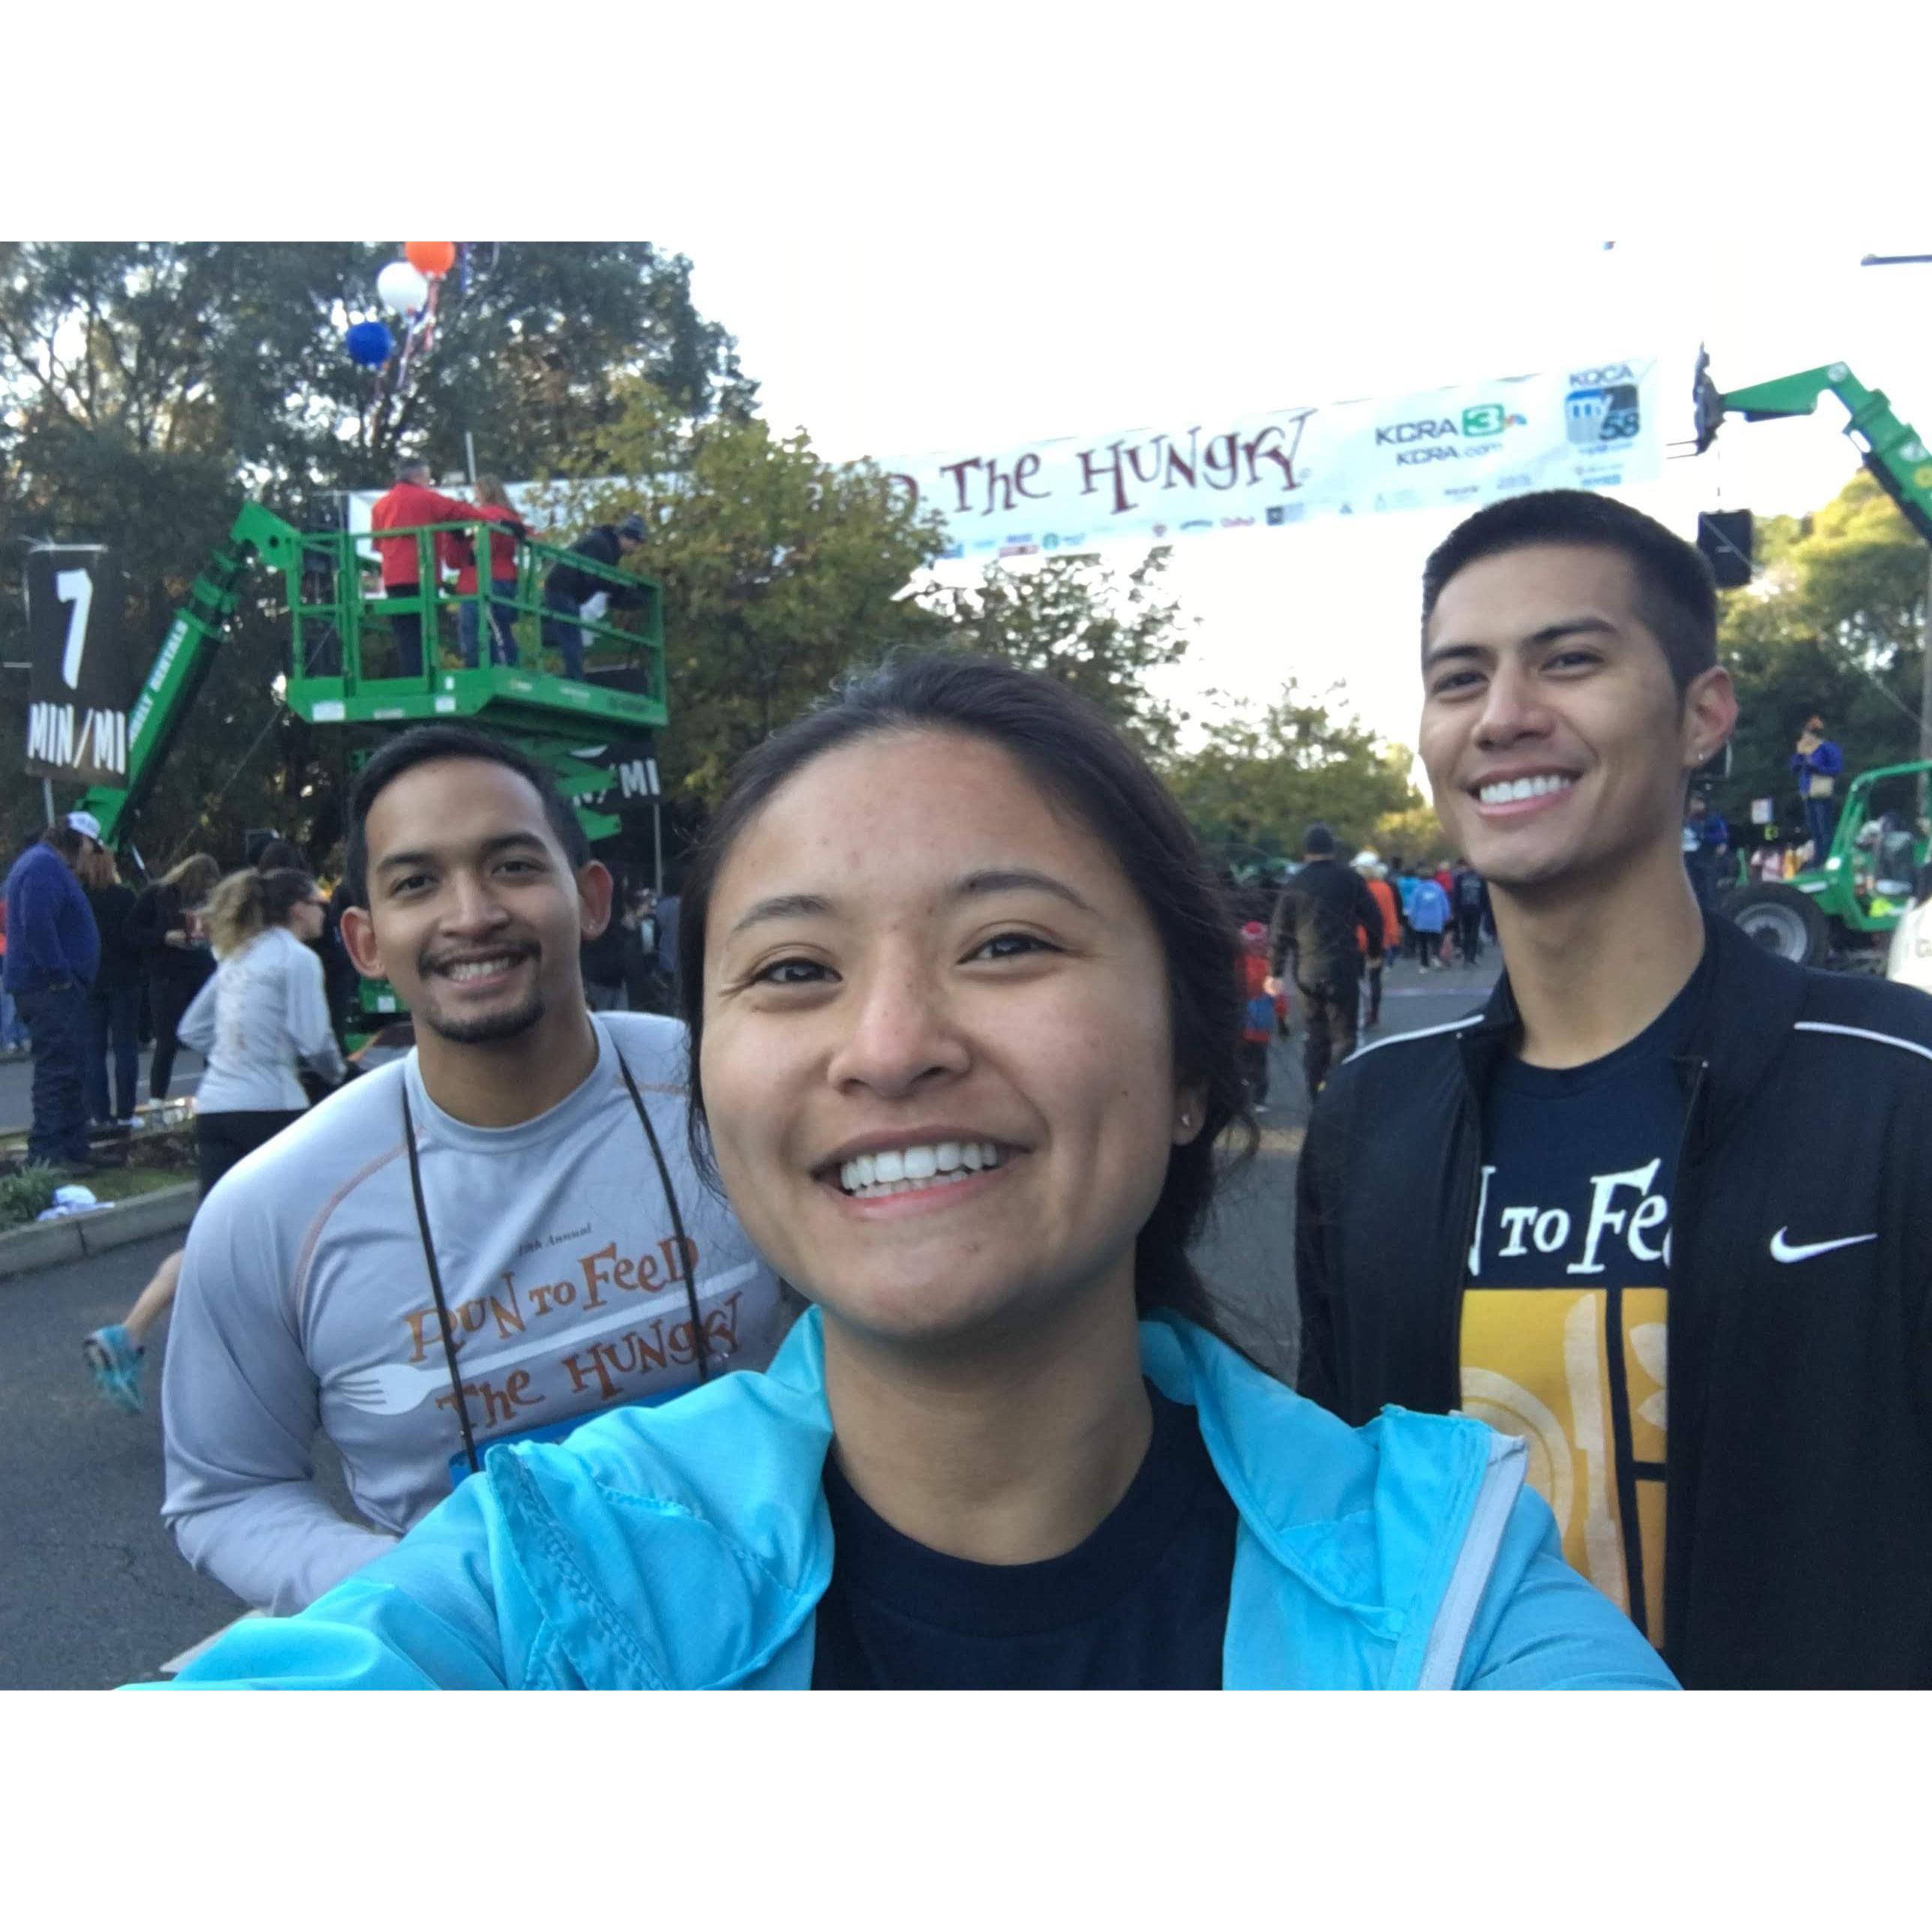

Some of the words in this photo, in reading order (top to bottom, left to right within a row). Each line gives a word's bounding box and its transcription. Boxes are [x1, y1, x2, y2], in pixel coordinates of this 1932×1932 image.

[1375, 418, 1459, 446] KCRA
[1598, 411, 1640, 442] 58
[939, 452, 1052, 516] The
[26, 699, 127, 776] MIN/MI
[405, 1271, 526, 1364] RUN
[434, 1369, 546, 1429] The
